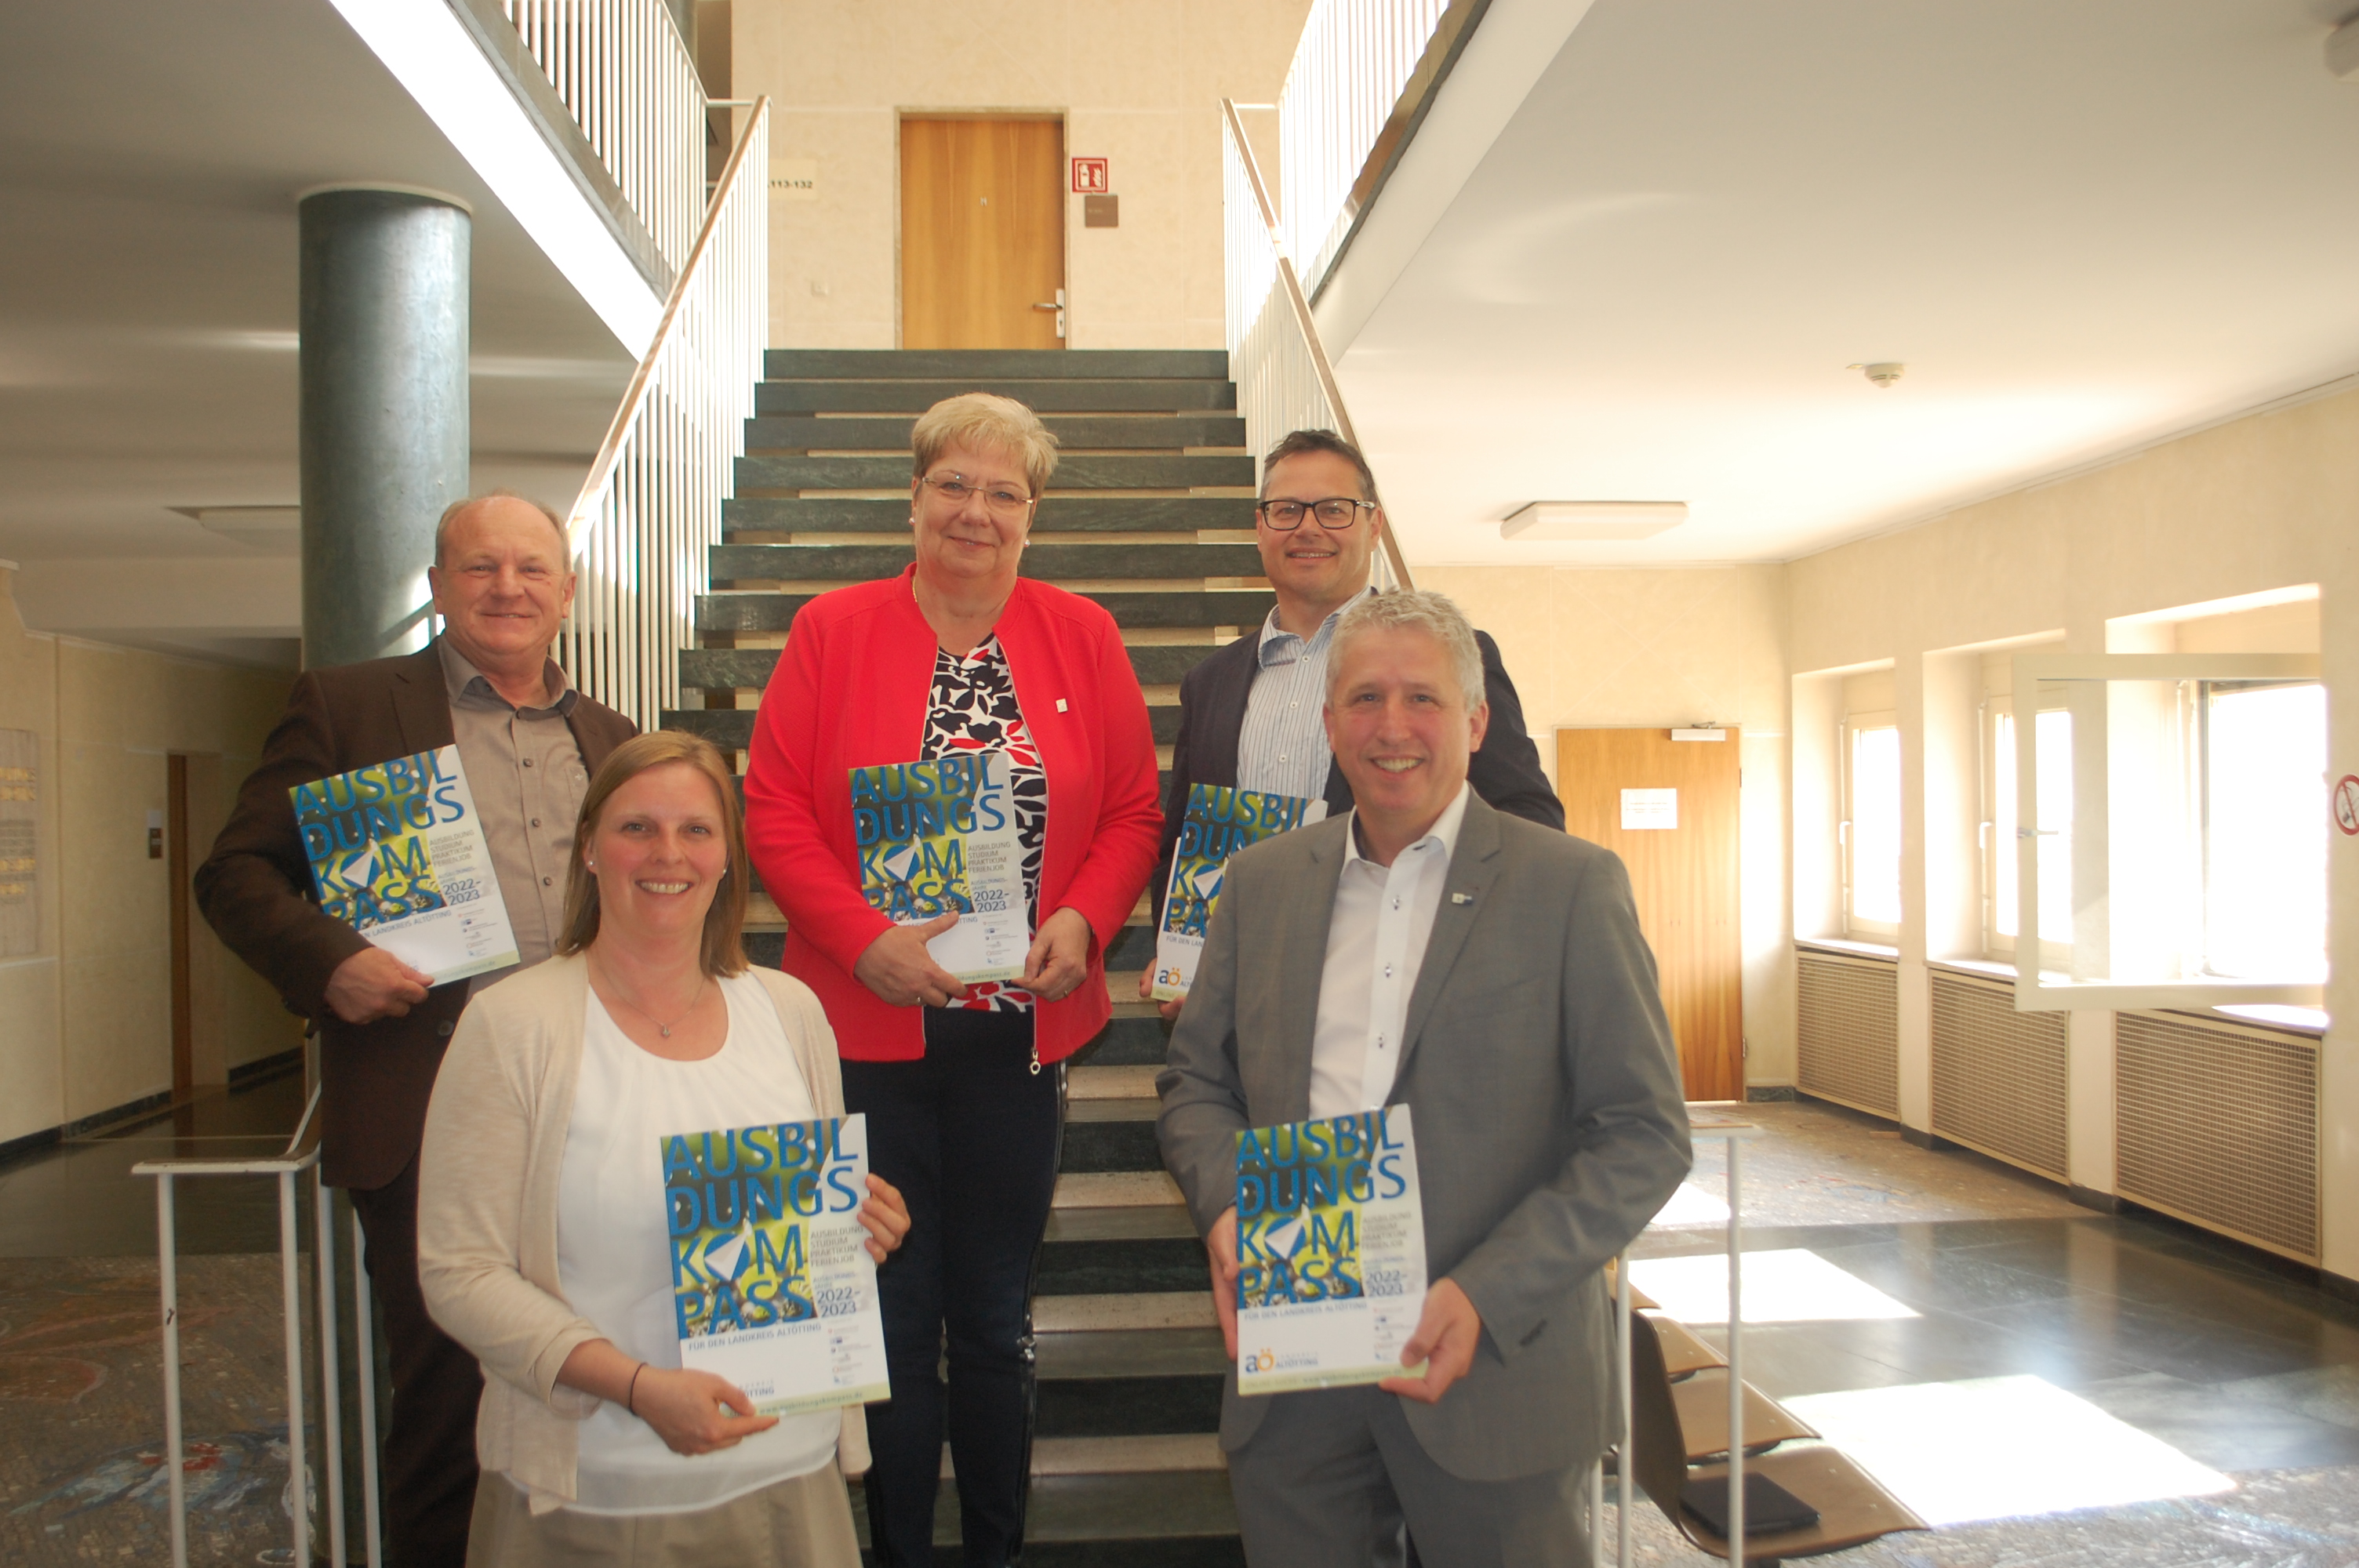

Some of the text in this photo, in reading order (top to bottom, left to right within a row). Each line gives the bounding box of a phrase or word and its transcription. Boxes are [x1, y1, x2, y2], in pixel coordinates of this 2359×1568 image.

[296, 749, 458, 819] AUSBIL
[851, 755, 1004, 804] AUSBIL
[300, 786, 465, 862] DUNGS
[853, 793, 1005, 846] DUNGS
[430, 829, 474, 846] AUSBILDUNG
[968, 841, 1011, 851] AUSBILDUNG
[1180, 822, 1278, 862] DUN
[431, 840, 463, 854] STUDIUM
[432, 845, 473, 861] PRAKTIKUM
[968, 850, 998, 859] STUDIUM
[311, 837, 428, 900] KOM
[434, 854, 472, 867] FERIENJOB
[858, 838, 964, 884] KOM
[968, 857, 1007, 866] PRAKTIKUM
[969, 864, 1005, 873] FERIENJOB
[443, 879, 482, 895] 2022-
[1171, 860, 1225, 900] KO
[322, 874, 442, 931] PASS
[448, 889, 480, 906] 2023
[863, 879, 971, 922] PASS
[974, 889, 1009, 902] 2022-
[976, 900, 1006, 913] 2023
[413, 909, 452, 925] ALTÖTTING
[1163, 898, 1208, 939] PA
[1237, 1107, 1405, 1171] AUSBIL
[664, 1117, 858, 1182] AUSBIL
[1237, 1154, 1406, 1218] DUNGS
[667, 1167, 859, 1236] DUNGS
[811, 1225, 864, 1240] AUSBILDUNG
[1238, 1210, 1356, 1263] KOM
[811, 1236, 848, 1249] STUDIUM
[811, 1245, 858, 1258] PRAKTIKUM
[672, 1225, 805, 1287] KOM
[811, 1254, 855, 1268] FERIENJOB
[1237, 1258, 1361, 1309] PASS
[1366, 1270, 1408, 1284] 2022-
[817, 1287, 860, 1305] 2022-
[1369, 1283, 1404, 1298] 2023
[676, 1276, 813, 1340] PASS
[820, 1301, 856, 1318] 2023
[1261, 1308, 1278, 1319] DEN
[1279, 1306, 1323, 1318] LANDKREIS
[1325, 1301, 1368, 1313] ALTÖTTING
[689, 1322, 822, 1352] FÜR DEN LANDKREIS ALTÖTTING
